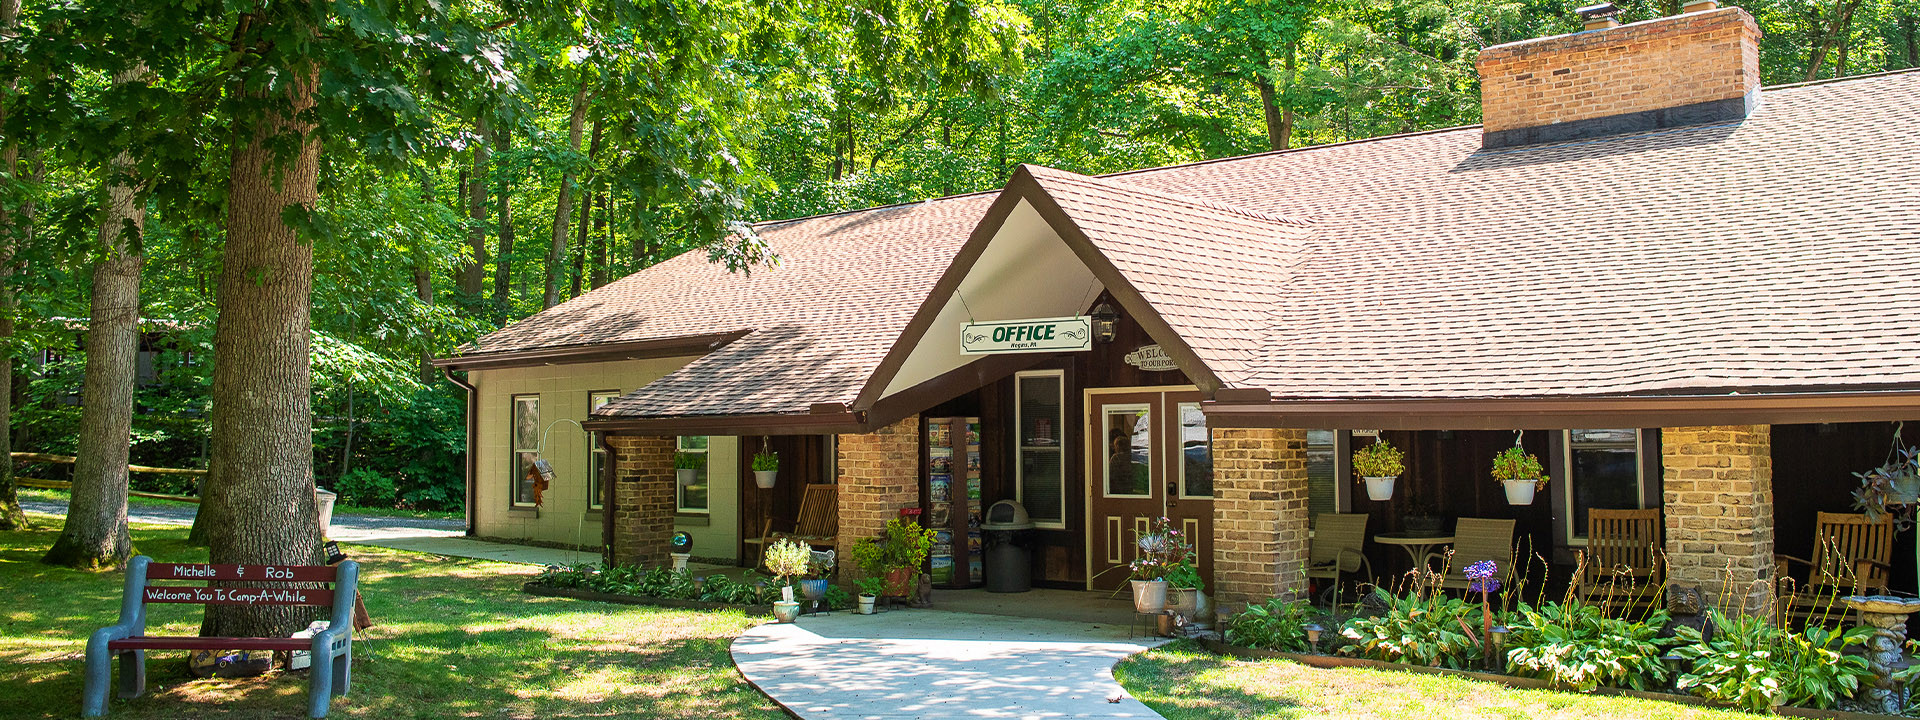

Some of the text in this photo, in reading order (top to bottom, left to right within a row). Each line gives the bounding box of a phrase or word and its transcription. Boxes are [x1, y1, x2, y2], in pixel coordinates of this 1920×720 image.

[992, 324, 1056, 343] OFFICE
[173, 565, 216, 577] Michelle
[265, 566, 294, 579] Rob
[146, 588, 306, 605] Welcome You To Camp-A-While
